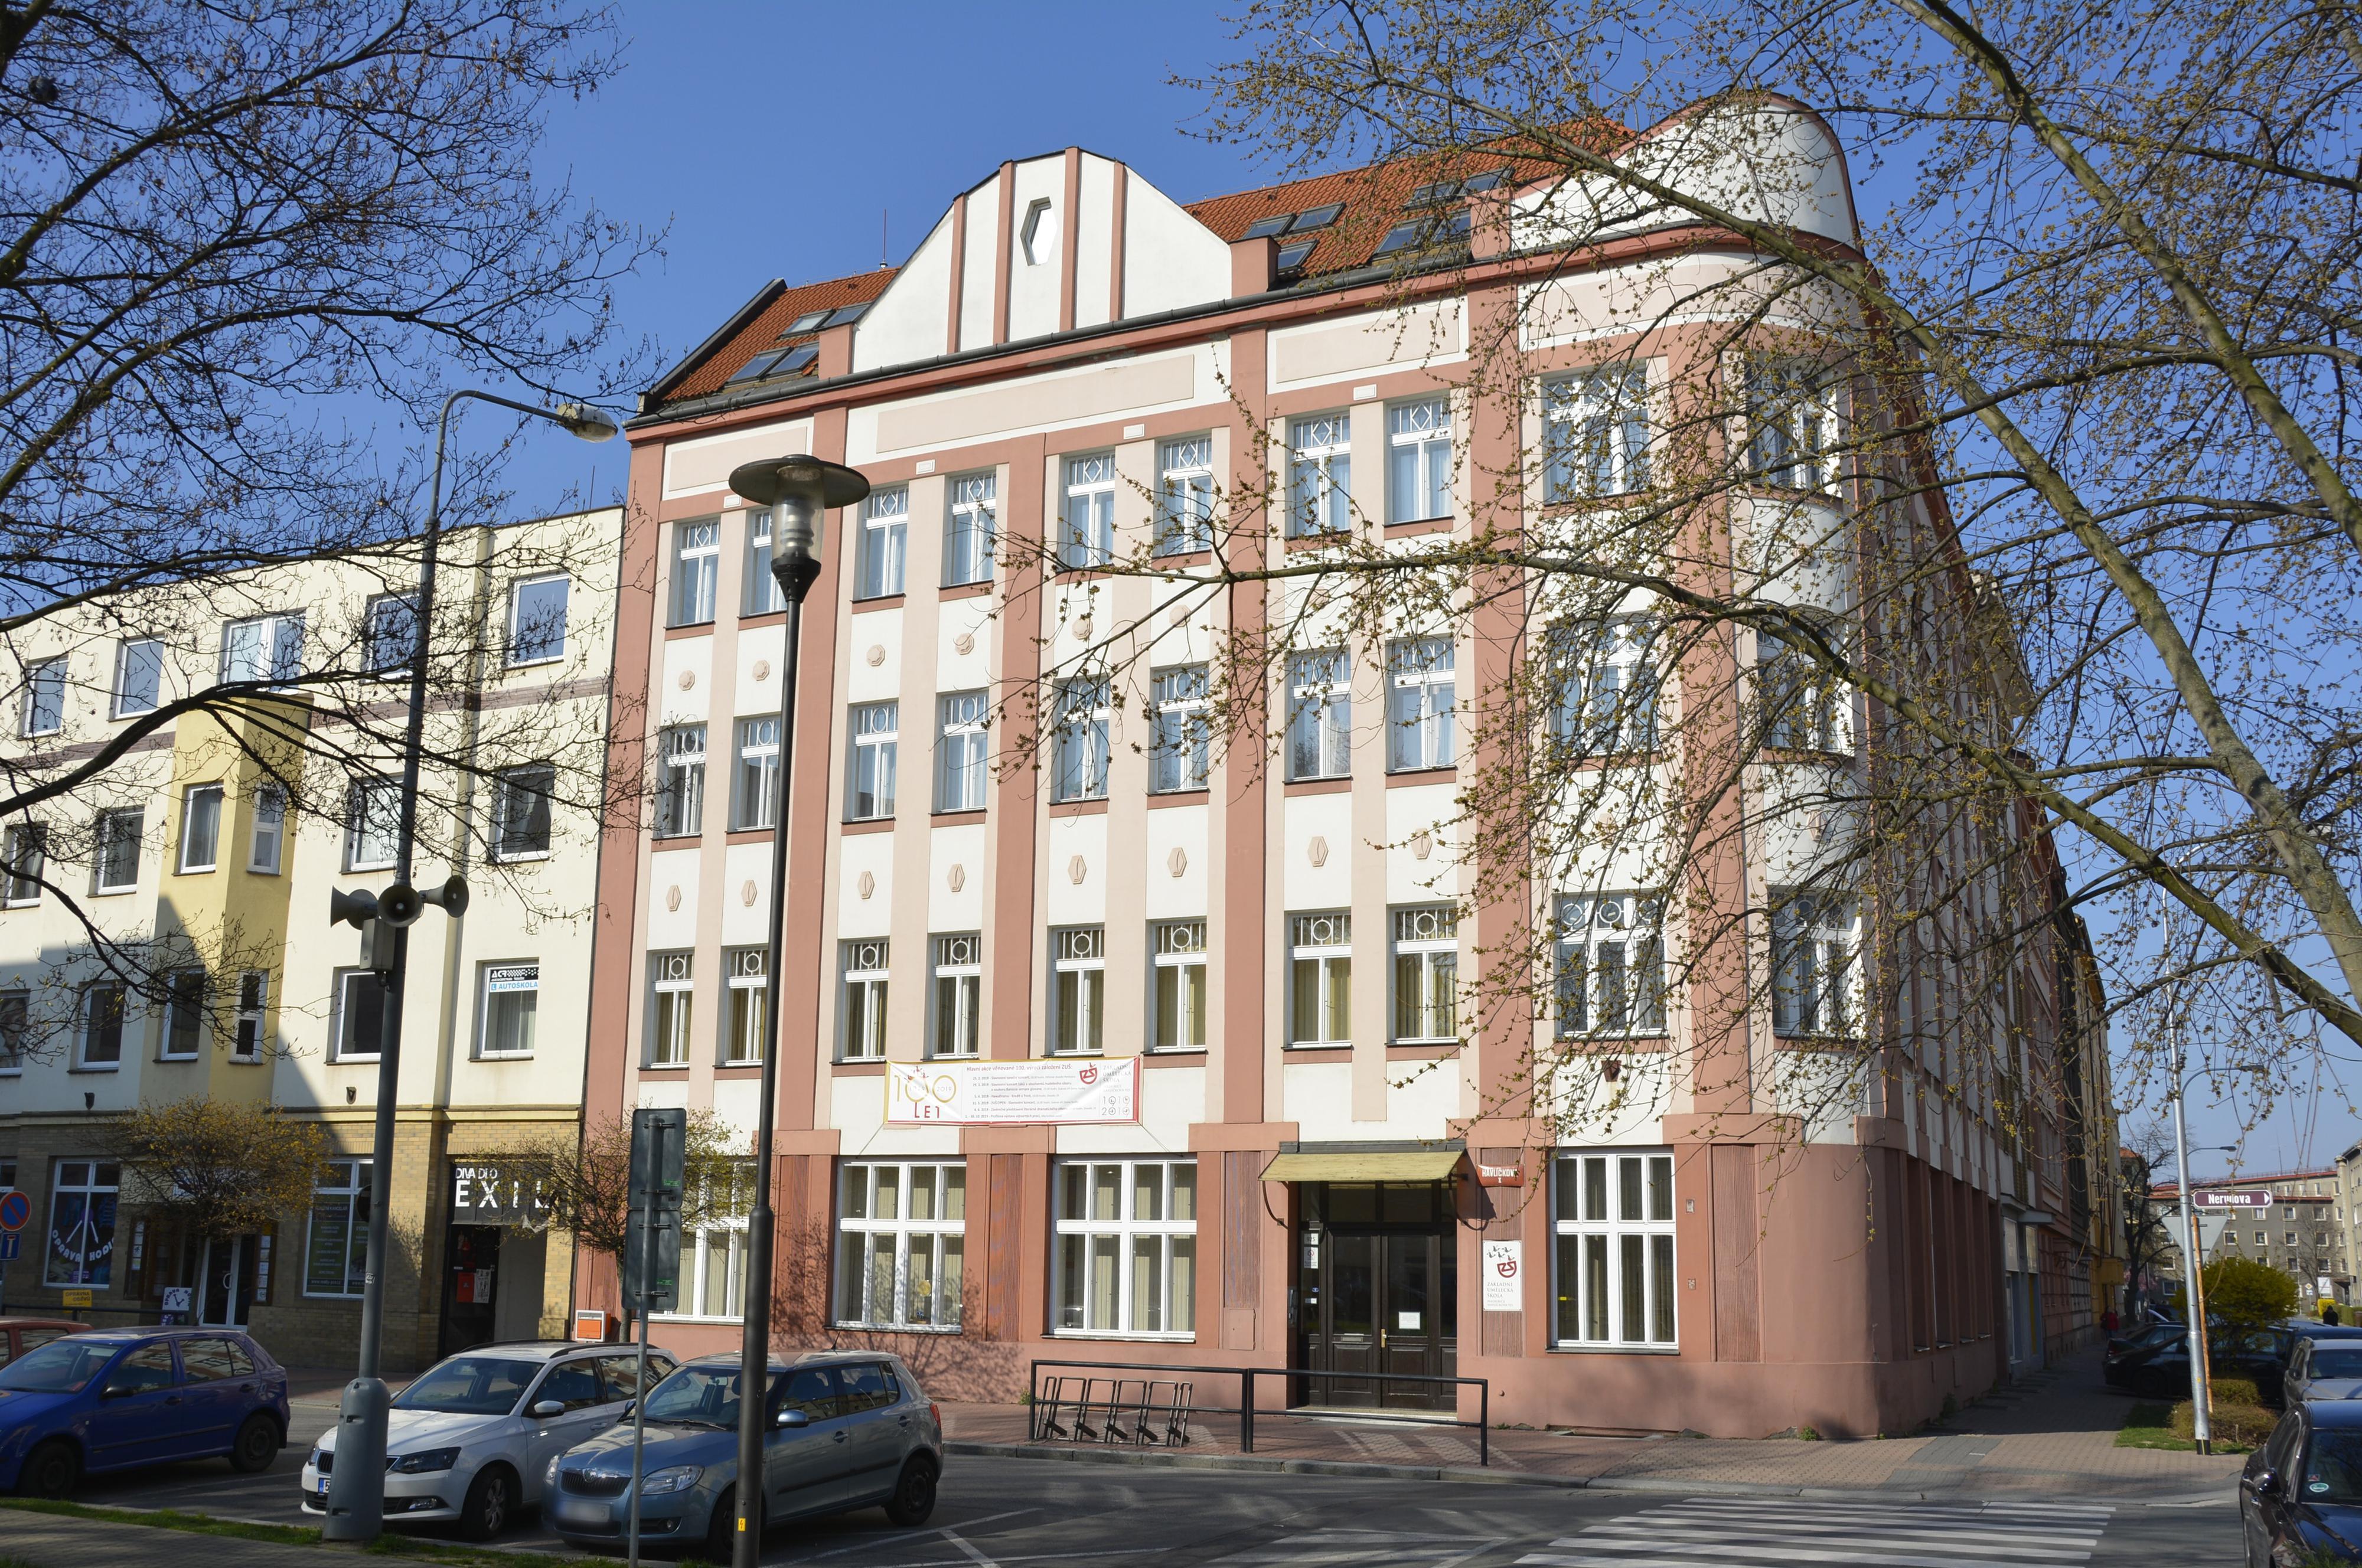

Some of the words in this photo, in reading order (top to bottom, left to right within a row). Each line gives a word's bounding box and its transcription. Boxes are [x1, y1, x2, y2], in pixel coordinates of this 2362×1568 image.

[455, 1168, 498, 1179] DIVADLO
[455, 1180, 550, 1208] EXIL
[52, 1229, 81, 1262] OPRAVA
[89, 1237, 114, 1262] HODI
